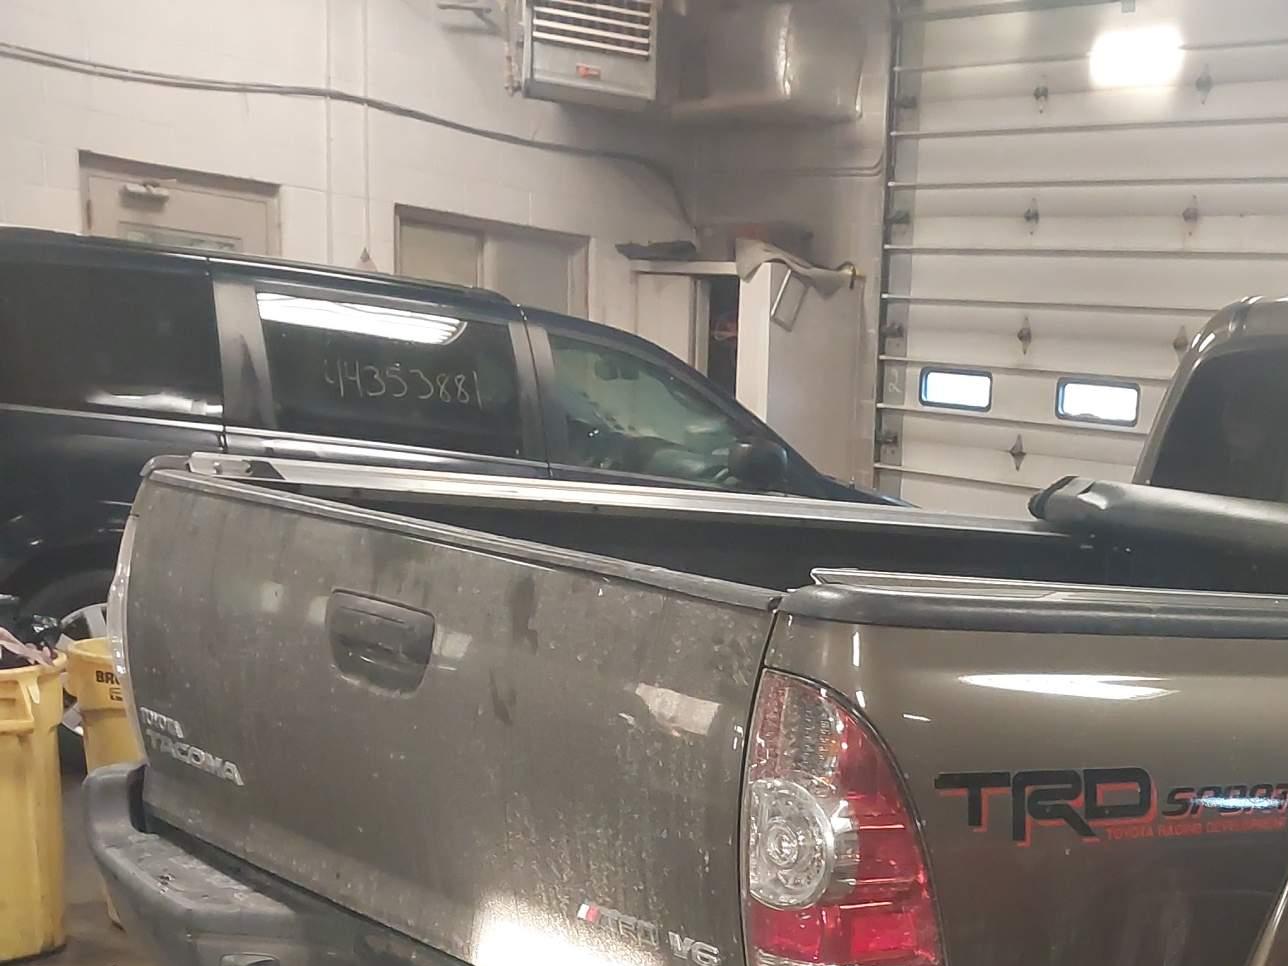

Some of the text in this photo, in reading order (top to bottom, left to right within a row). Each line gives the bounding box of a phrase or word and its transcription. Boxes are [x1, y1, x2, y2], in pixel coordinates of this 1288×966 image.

[323, 358, 483, 411] 44353881
[146, 728, 245, 787] TACOMA
[934, 767, 1156, 846] TRD
